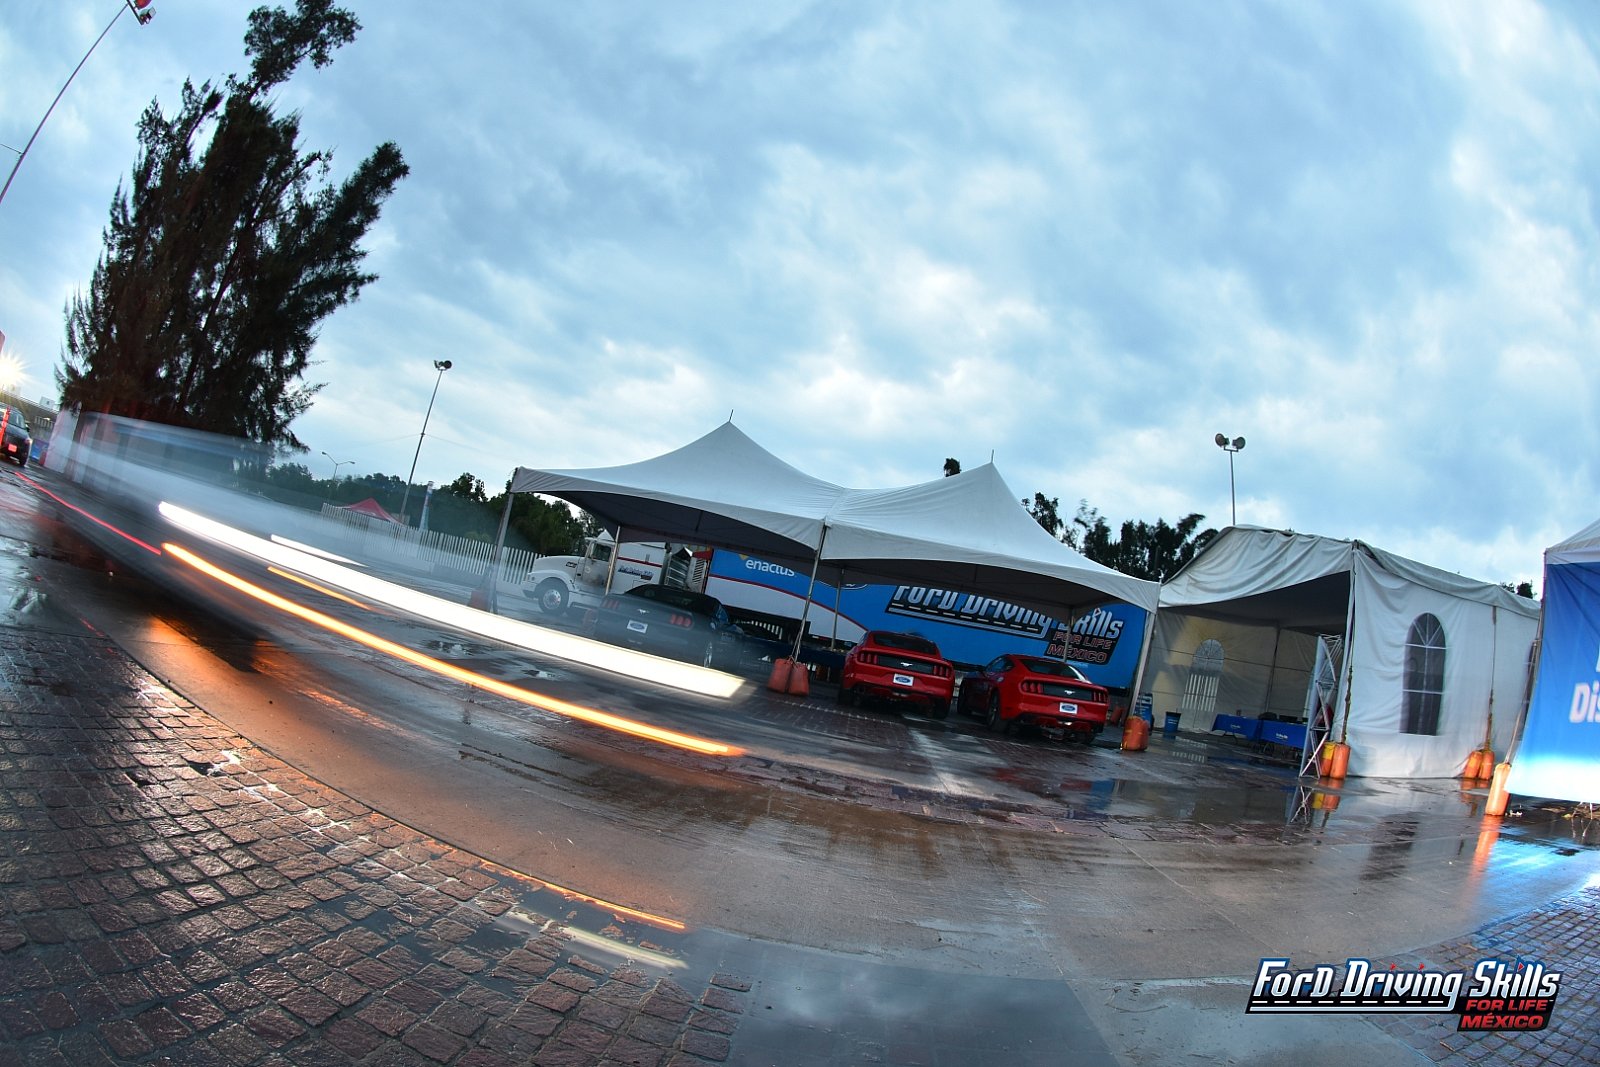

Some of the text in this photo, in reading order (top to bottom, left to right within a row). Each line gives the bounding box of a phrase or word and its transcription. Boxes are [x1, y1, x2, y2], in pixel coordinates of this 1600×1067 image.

[745, 559, 795, 577] enactus
[1053, 631, 1113, 650] FOR LIFE
